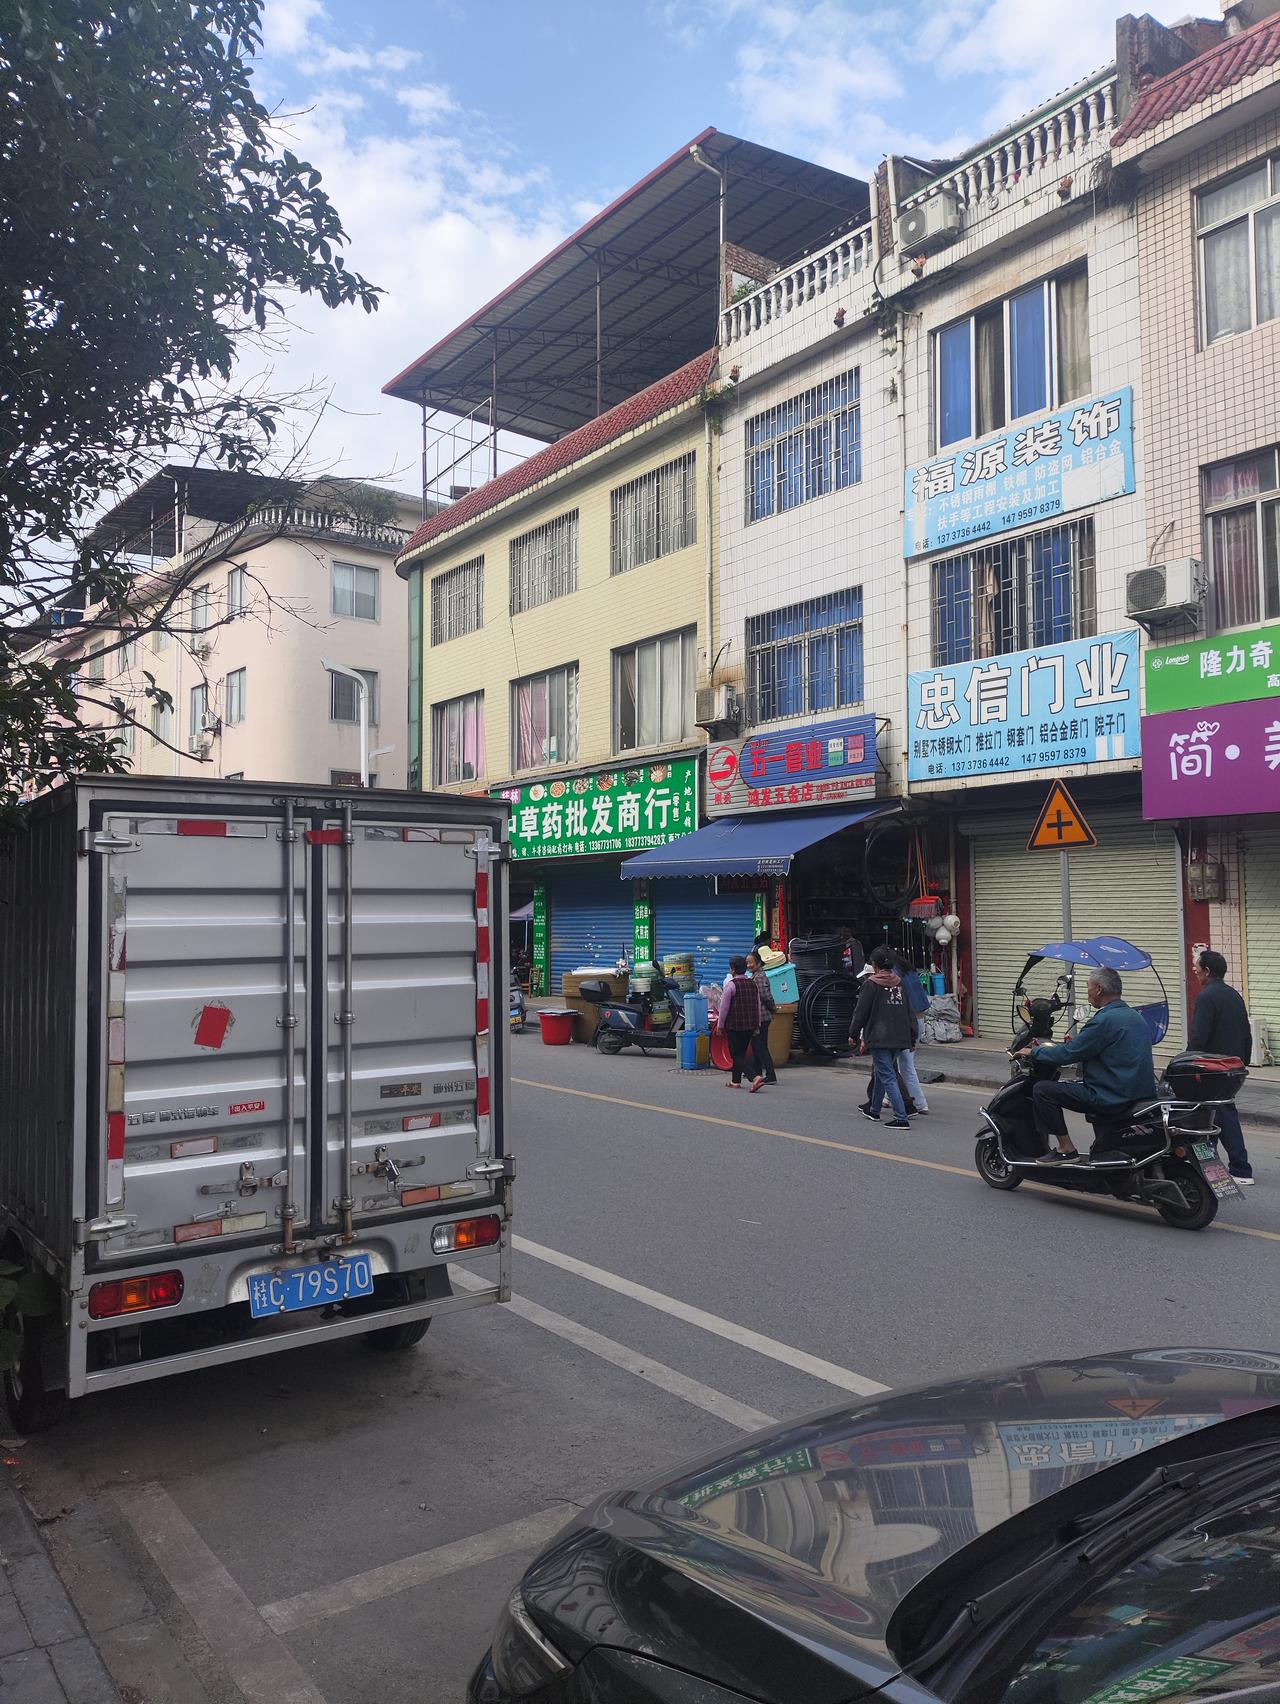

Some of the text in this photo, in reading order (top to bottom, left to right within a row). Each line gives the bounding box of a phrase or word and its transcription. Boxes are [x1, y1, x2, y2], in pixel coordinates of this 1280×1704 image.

[912, 398, 1121, 502] 福源装饰
[940, 480, 997, 511] 不锈钢雨棚
[1035, 454, 1073, 481] 防盗网
[1081, 439, 1122, 464] 铝合金
[937, 480, 1060, 532] 扶手等工程安装及加工
[1200, 640, 1274, 679] 隆力奇
[916, 642, 1130, 731] 忠信门业
[913, 712, 1126, 758] 别墅不锈钢大门 推拉门 钢套门 铝合金房门 院子门
[502, 788, 519, 803] 桂林
[683, 769, 693, 828] 产地直销
[748, 783, 813, 807] 鸿发五金店
